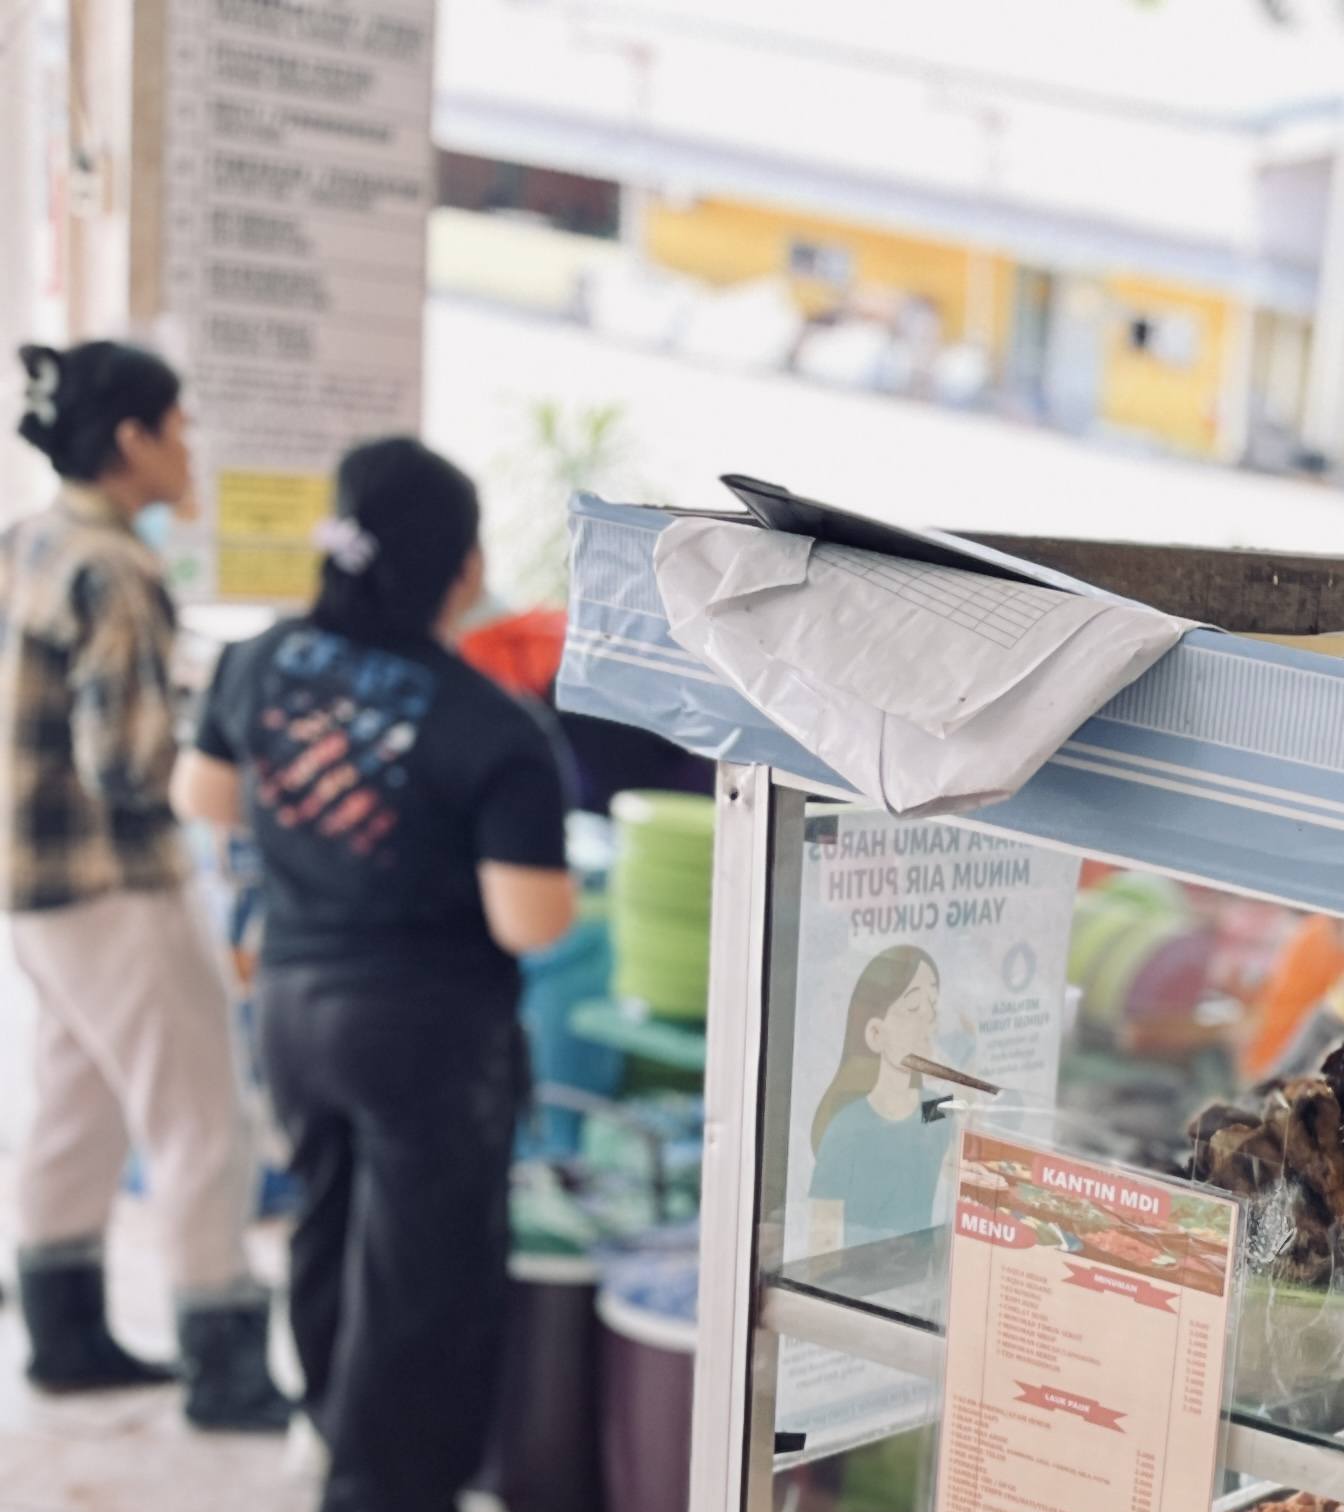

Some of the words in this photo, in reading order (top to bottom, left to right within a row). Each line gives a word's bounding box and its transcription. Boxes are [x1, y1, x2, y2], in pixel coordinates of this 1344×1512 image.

[1043, 1166, 1116, 1201] KANTIN
[1120, 1190, 1159, 1215] MDI
[961, 1212, 1016, 1242] MENU
